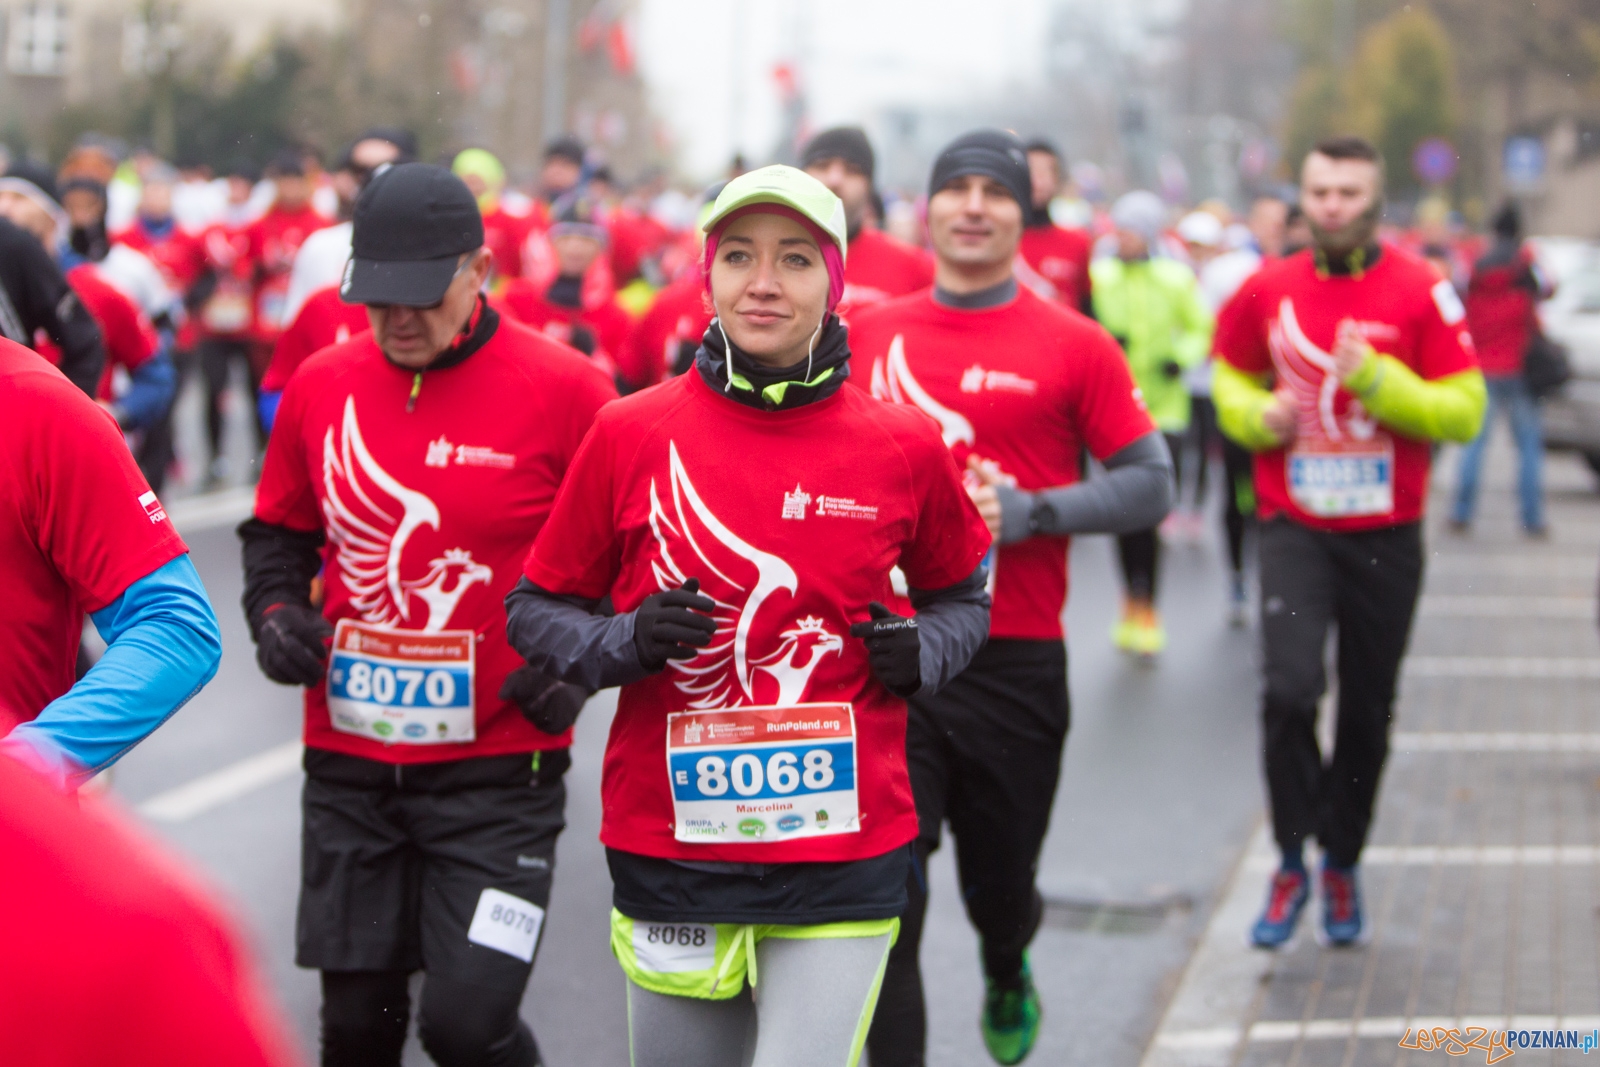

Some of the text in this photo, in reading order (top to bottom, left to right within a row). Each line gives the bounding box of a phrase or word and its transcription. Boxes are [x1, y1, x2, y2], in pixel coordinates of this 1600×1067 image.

[815, 495, 825, 515] 1
[346, 661, 455, 707] 8070
[707, 723, 716, 739] 1
[766, 719, 840, 733] RunPoland.org
[675, 749, 835, 797] E 8068
[736, 803, 793, 813] Marcelina
[685, 819, 713, 828] GRUPA
[685, 827, 718, 836] LUXMED
[490, 903, 536, 935] 8070
[647, 925, 707, 947] 8068
